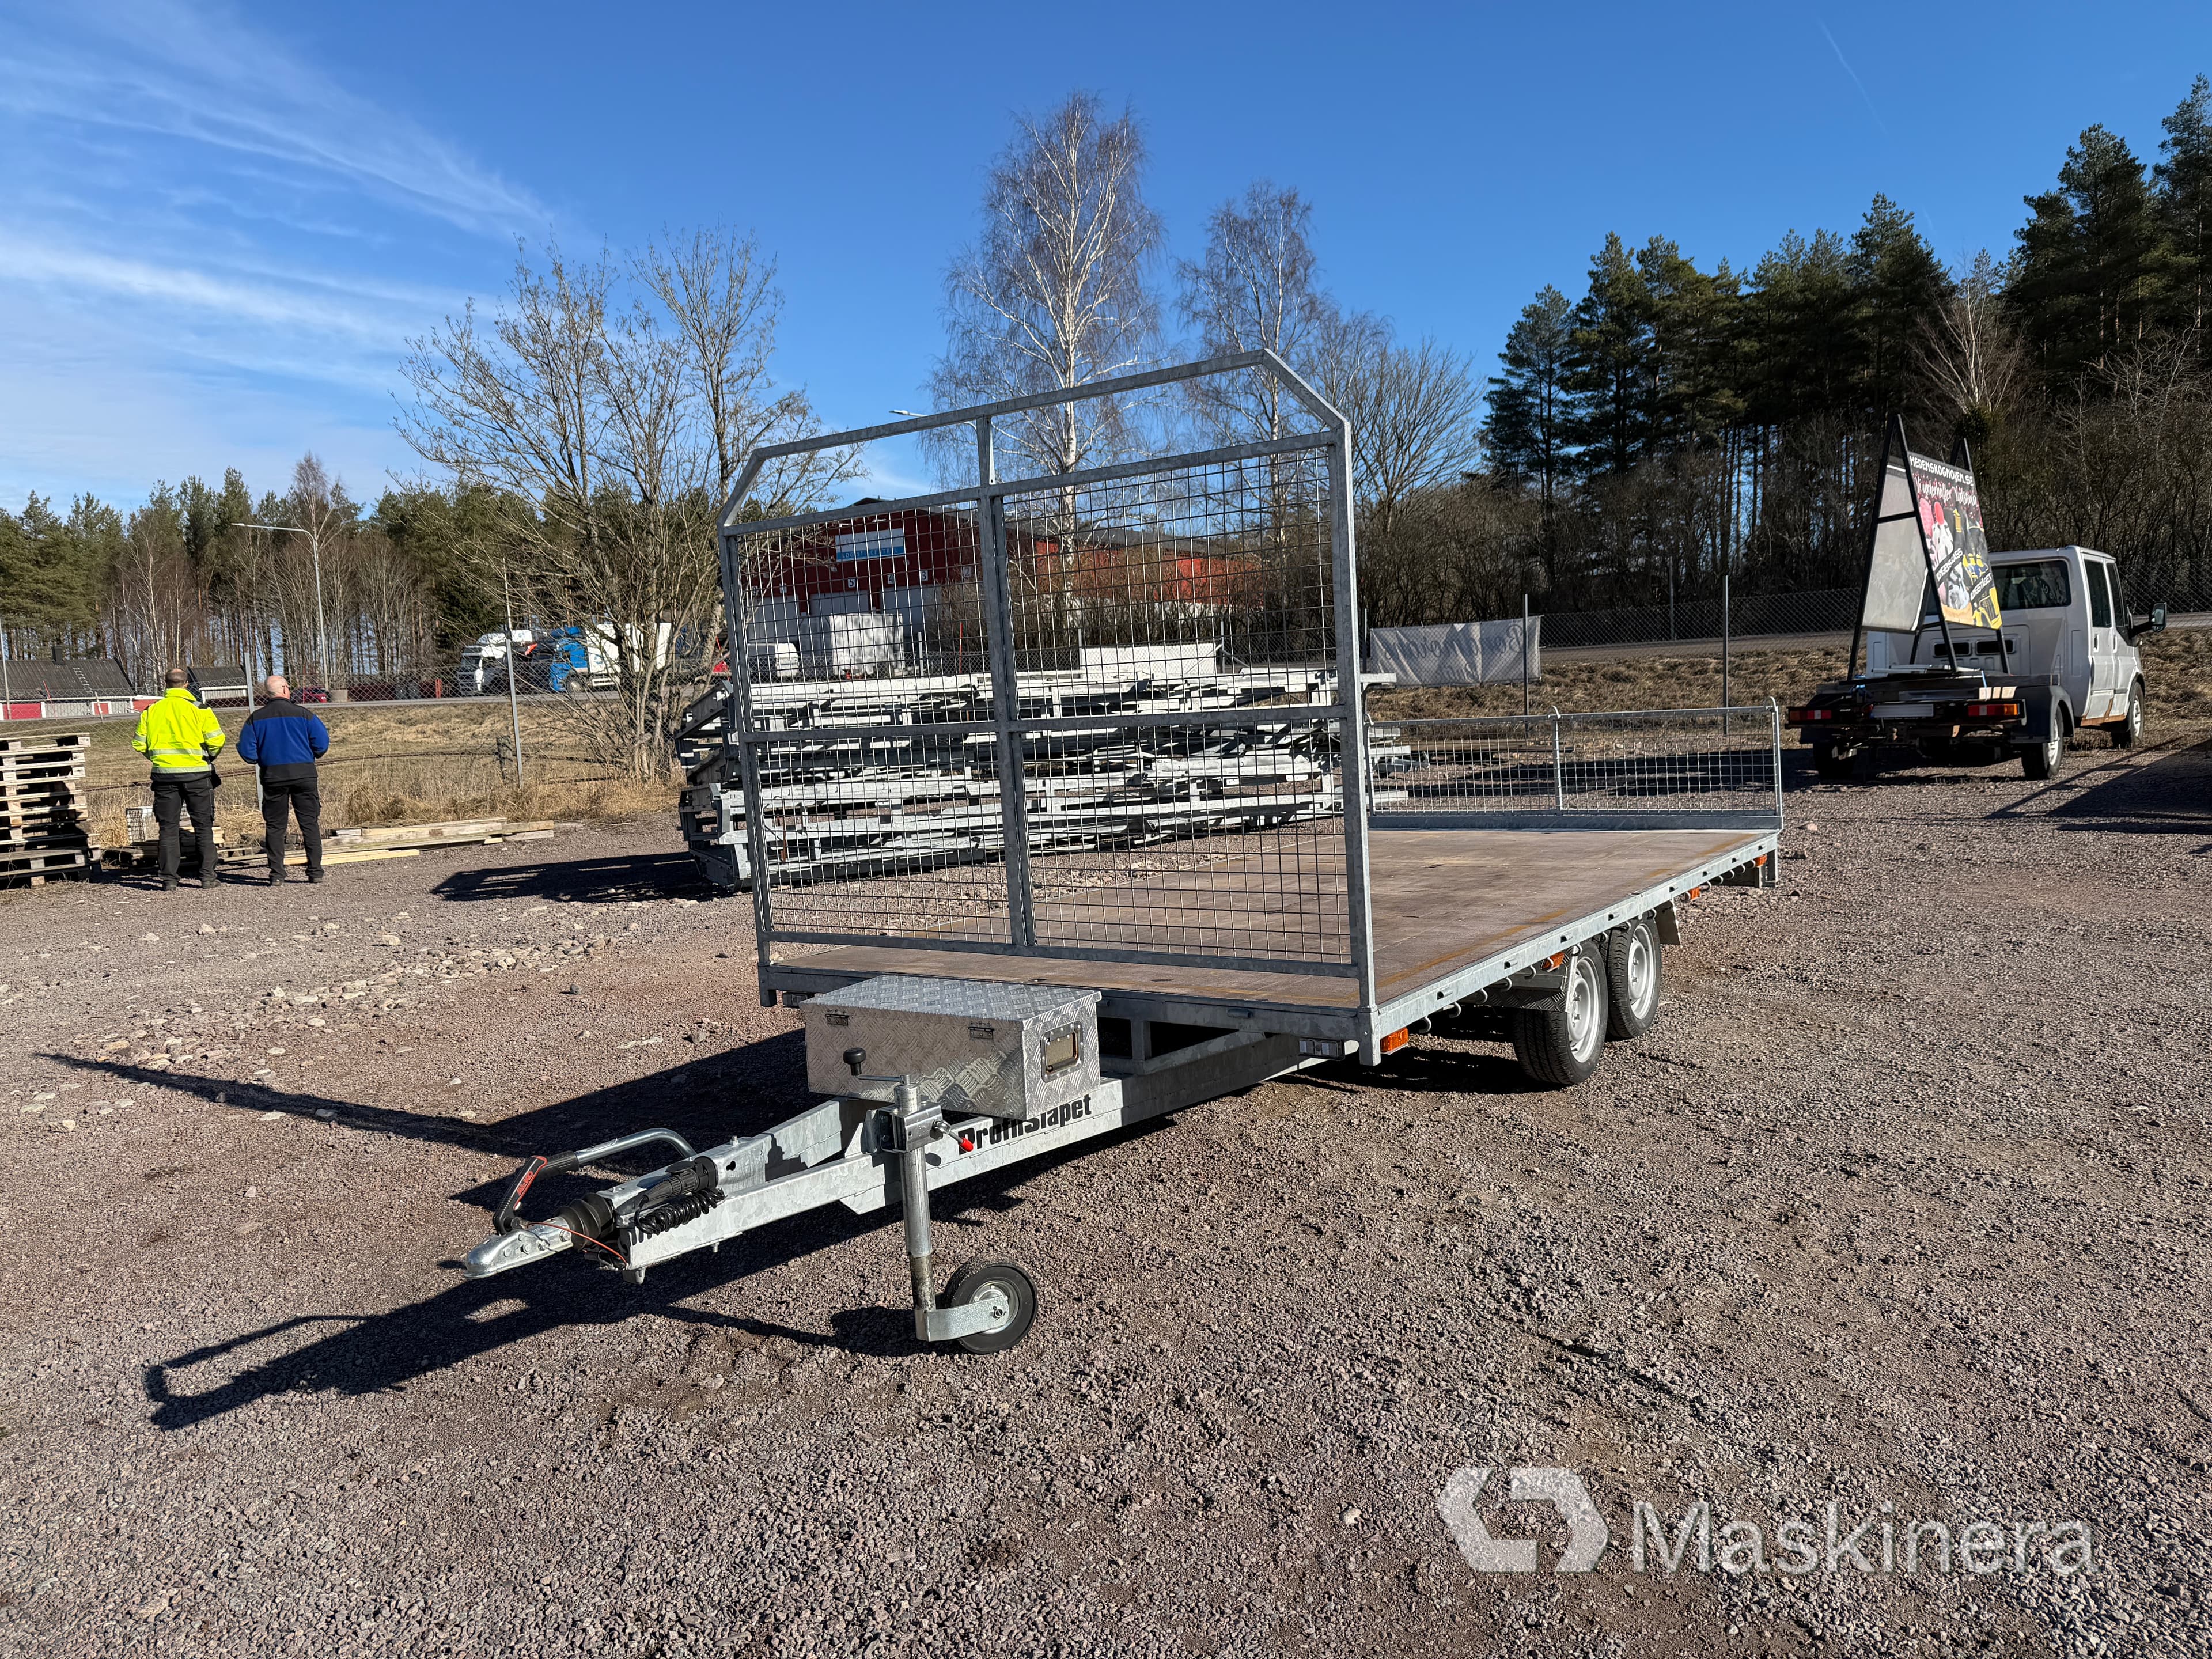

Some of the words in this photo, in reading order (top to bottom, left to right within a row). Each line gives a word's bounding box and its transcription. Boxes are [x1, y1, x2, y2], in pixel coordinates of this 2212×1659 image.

[888, 575, 893, 583] 4
[922, 571, 927, 580] 3
[849, 579, 854, 587] 5
